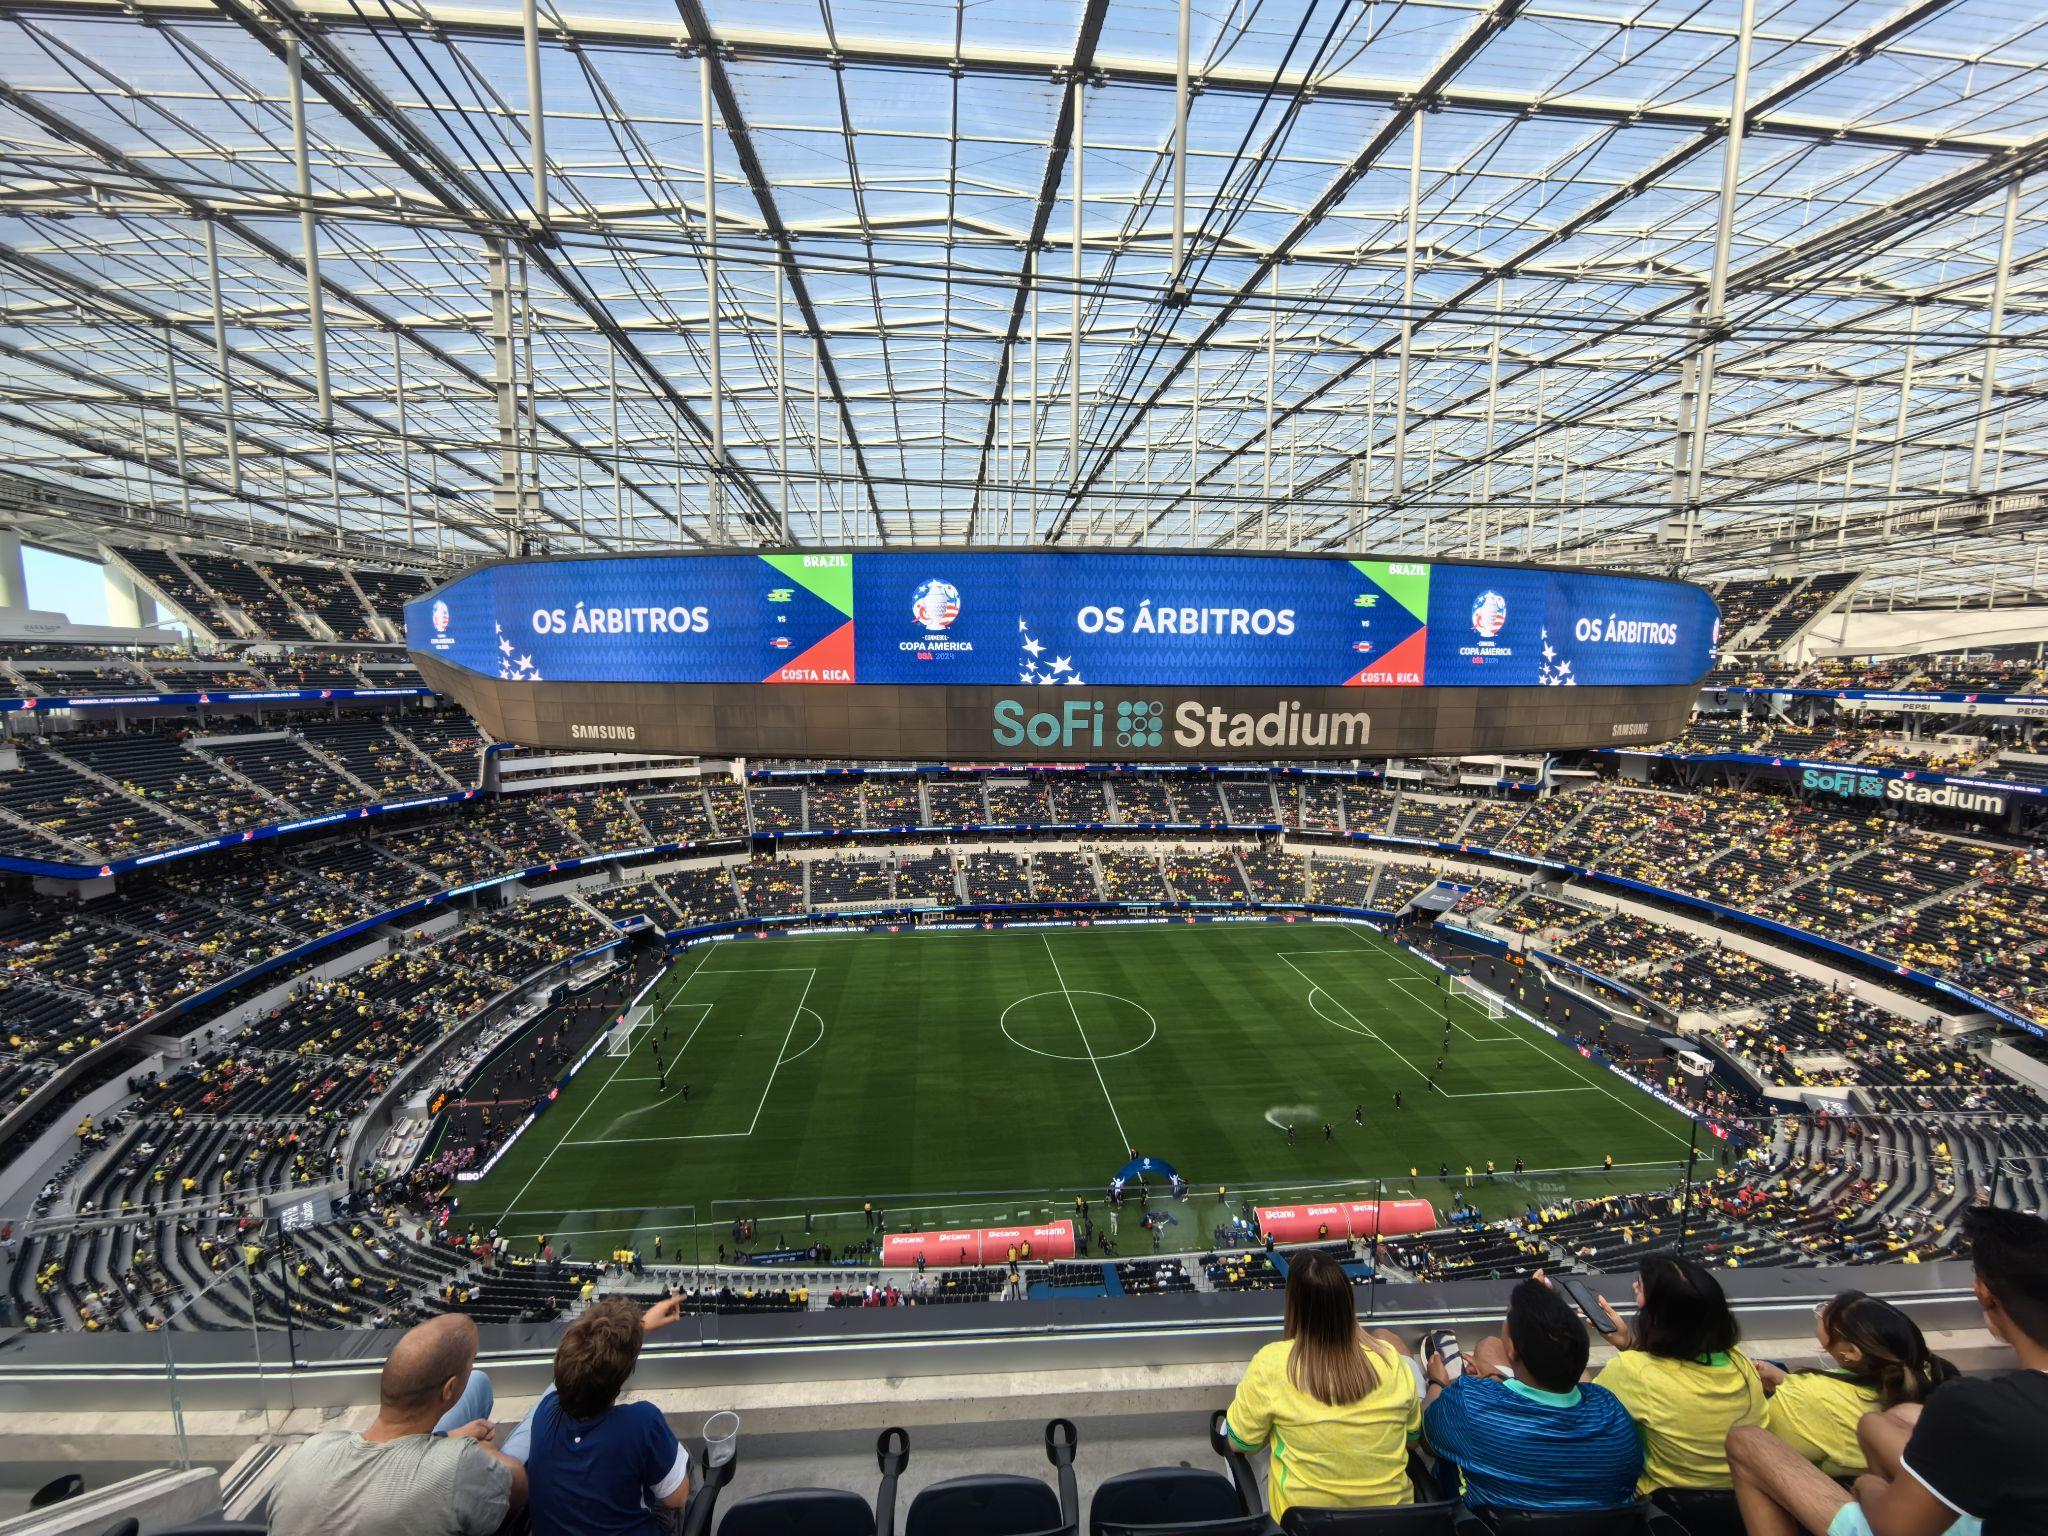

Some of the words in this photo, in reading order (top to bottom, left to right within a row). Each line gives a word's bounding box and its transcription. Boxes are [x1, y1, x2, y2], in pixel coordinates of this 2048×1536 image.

[803, 556, 847, 568] BRAZIL
[1389, 564, 1426, 576] BRAZIL
[532, 609, 566, 634] OS
[571, 601, 709, 634] ÁRBITROS
[1078, 606, 1124, 635] OS
[1132, 599, 1296, 635] ÁRBITROS
[1575, 617, 1601, 642] OS
[1605, 613, 1678, 645] ÁRBITROS
[899, 642, 926, 651] COPA
[927, 642, 973, 651] AMERICA
[1460, 647, 1479, 656] COPA
[1480, 647, 1512, 656] AMERICA
[917, 652, 933, 660] USA
[935, 652, 955, 660] 2024
[781, 669, 820, 681] COSTA
[823, 669, 850, 681] RICA
[1361, 672, 1393, 683] COSTA
[1397, 673, 1419, 683] RICA
[1903, 703, 1930, 711] PEPSI
[993, 700, 1104, 747] SoFi
[1174, 700, 1371, 748] Stadium
[1612, 723, 1649, 737] SAMSUNG
[572, 724, 636, 741] SAMSUNG
[1802, 769, 1856, 795] SoFi
[1886, 779, 2003, 815] Stadium
[1935, 980, 1970, 1001] CONMEBOL
[1970, 996, 1986, 1009] COPA
[1986, 1003, 2013, 1022] AMERICA
[2014, 1018, 2027, 1029] USA
[1609, 1065, 1638, 1085] ROCKING
[1639, 1080, 1654, 1095] THE
[1654, 1091, 1699, 1120] CONTINENT
[1265, 1210, 1296, 1220] Betano
[938, 1233, 971, 1242] Betano
[1034, 1227, 1066, 1236] Betano
[892, 1236, 925, 1245] Betano
